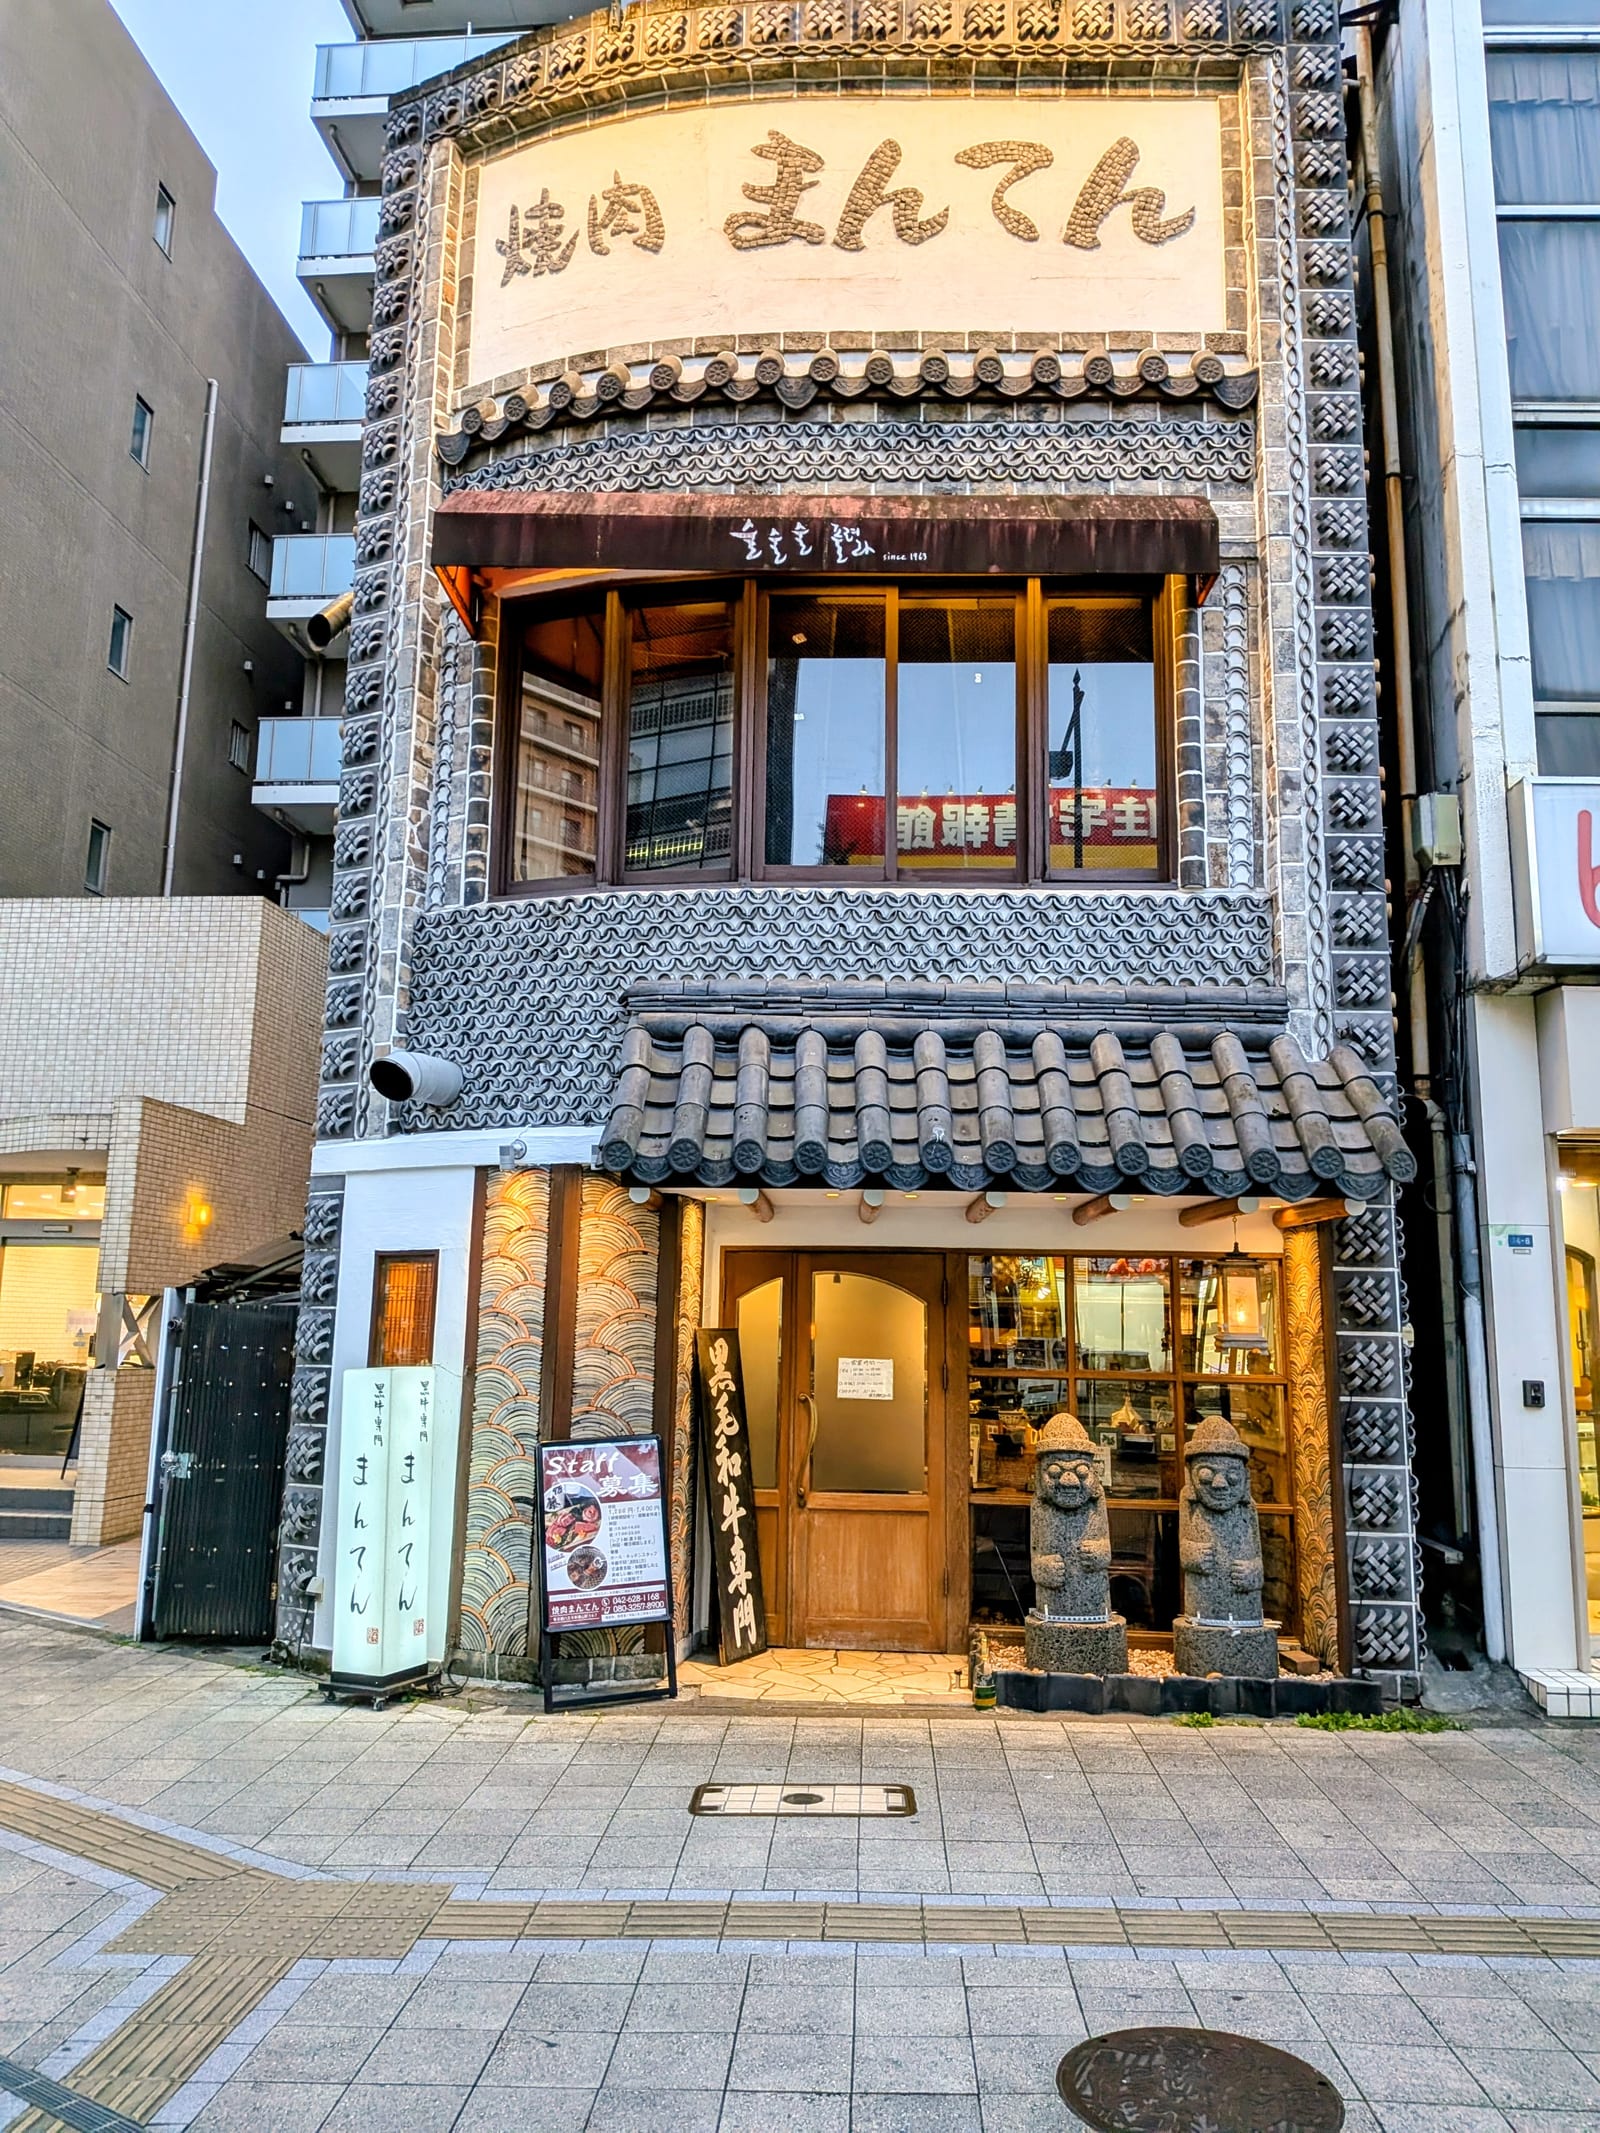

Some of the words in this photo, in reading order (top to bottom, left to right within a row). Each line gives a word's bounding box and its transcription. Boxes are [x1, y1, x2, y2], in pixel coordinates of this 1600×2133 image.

[495, 169, 666, 289] 焼肉
[723, 128, 1196, 251] まんてん
[882, 553, 907, 561] since
[545, 1451, 620, 1475] Staff
[596, 1473, 659, 1498] 募集
[708, 1337, 757, 1649] 黒毛和牛専門
[350, 1453, 372, 1615] まんてん
[398, 1451, 418, 1611] まんてん
[551, 1602, 600, 1615] 焼肉まんてん
[612, 1592, 660, 1605] 042-628-1168
[612, 1600, 665, 1613] 080-3257-8900
